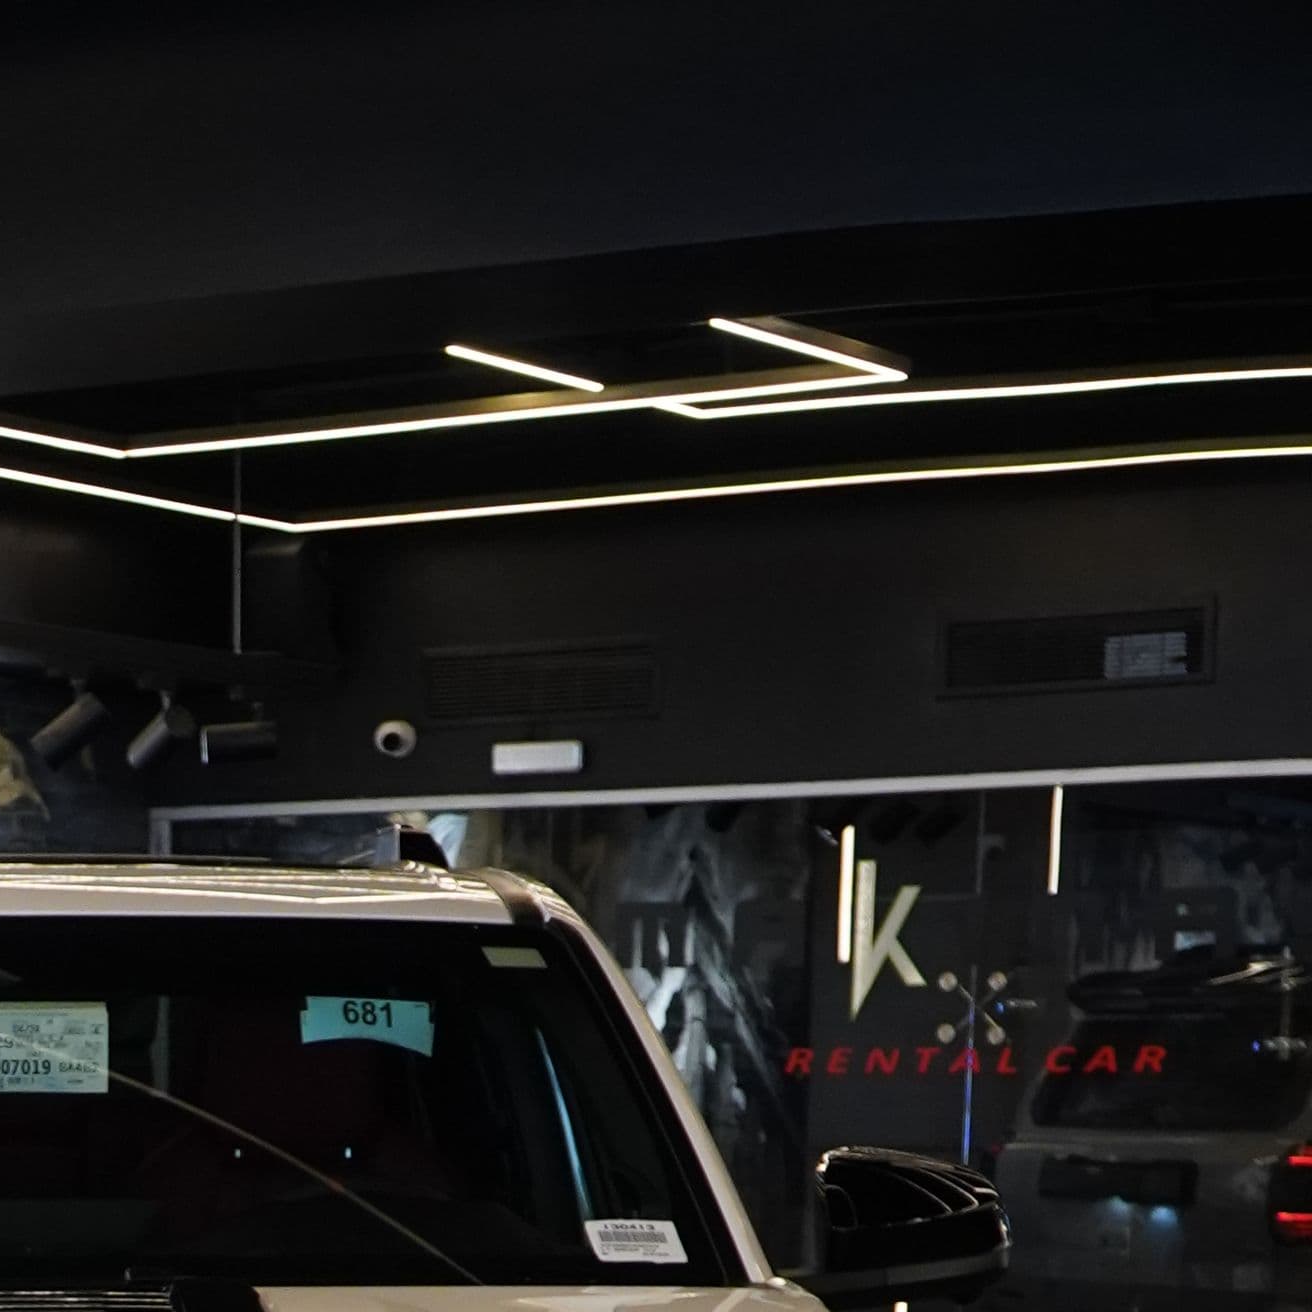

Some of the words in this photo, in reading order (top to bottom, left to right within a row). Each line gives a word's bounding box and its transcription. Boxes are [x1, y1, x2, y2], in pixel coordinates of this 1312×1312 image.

[343, 1000, 393, 1028] 681
[784, 1044, 1019, 1076] RENTAL
[1044, 1044, 1169, 1075] CAR
